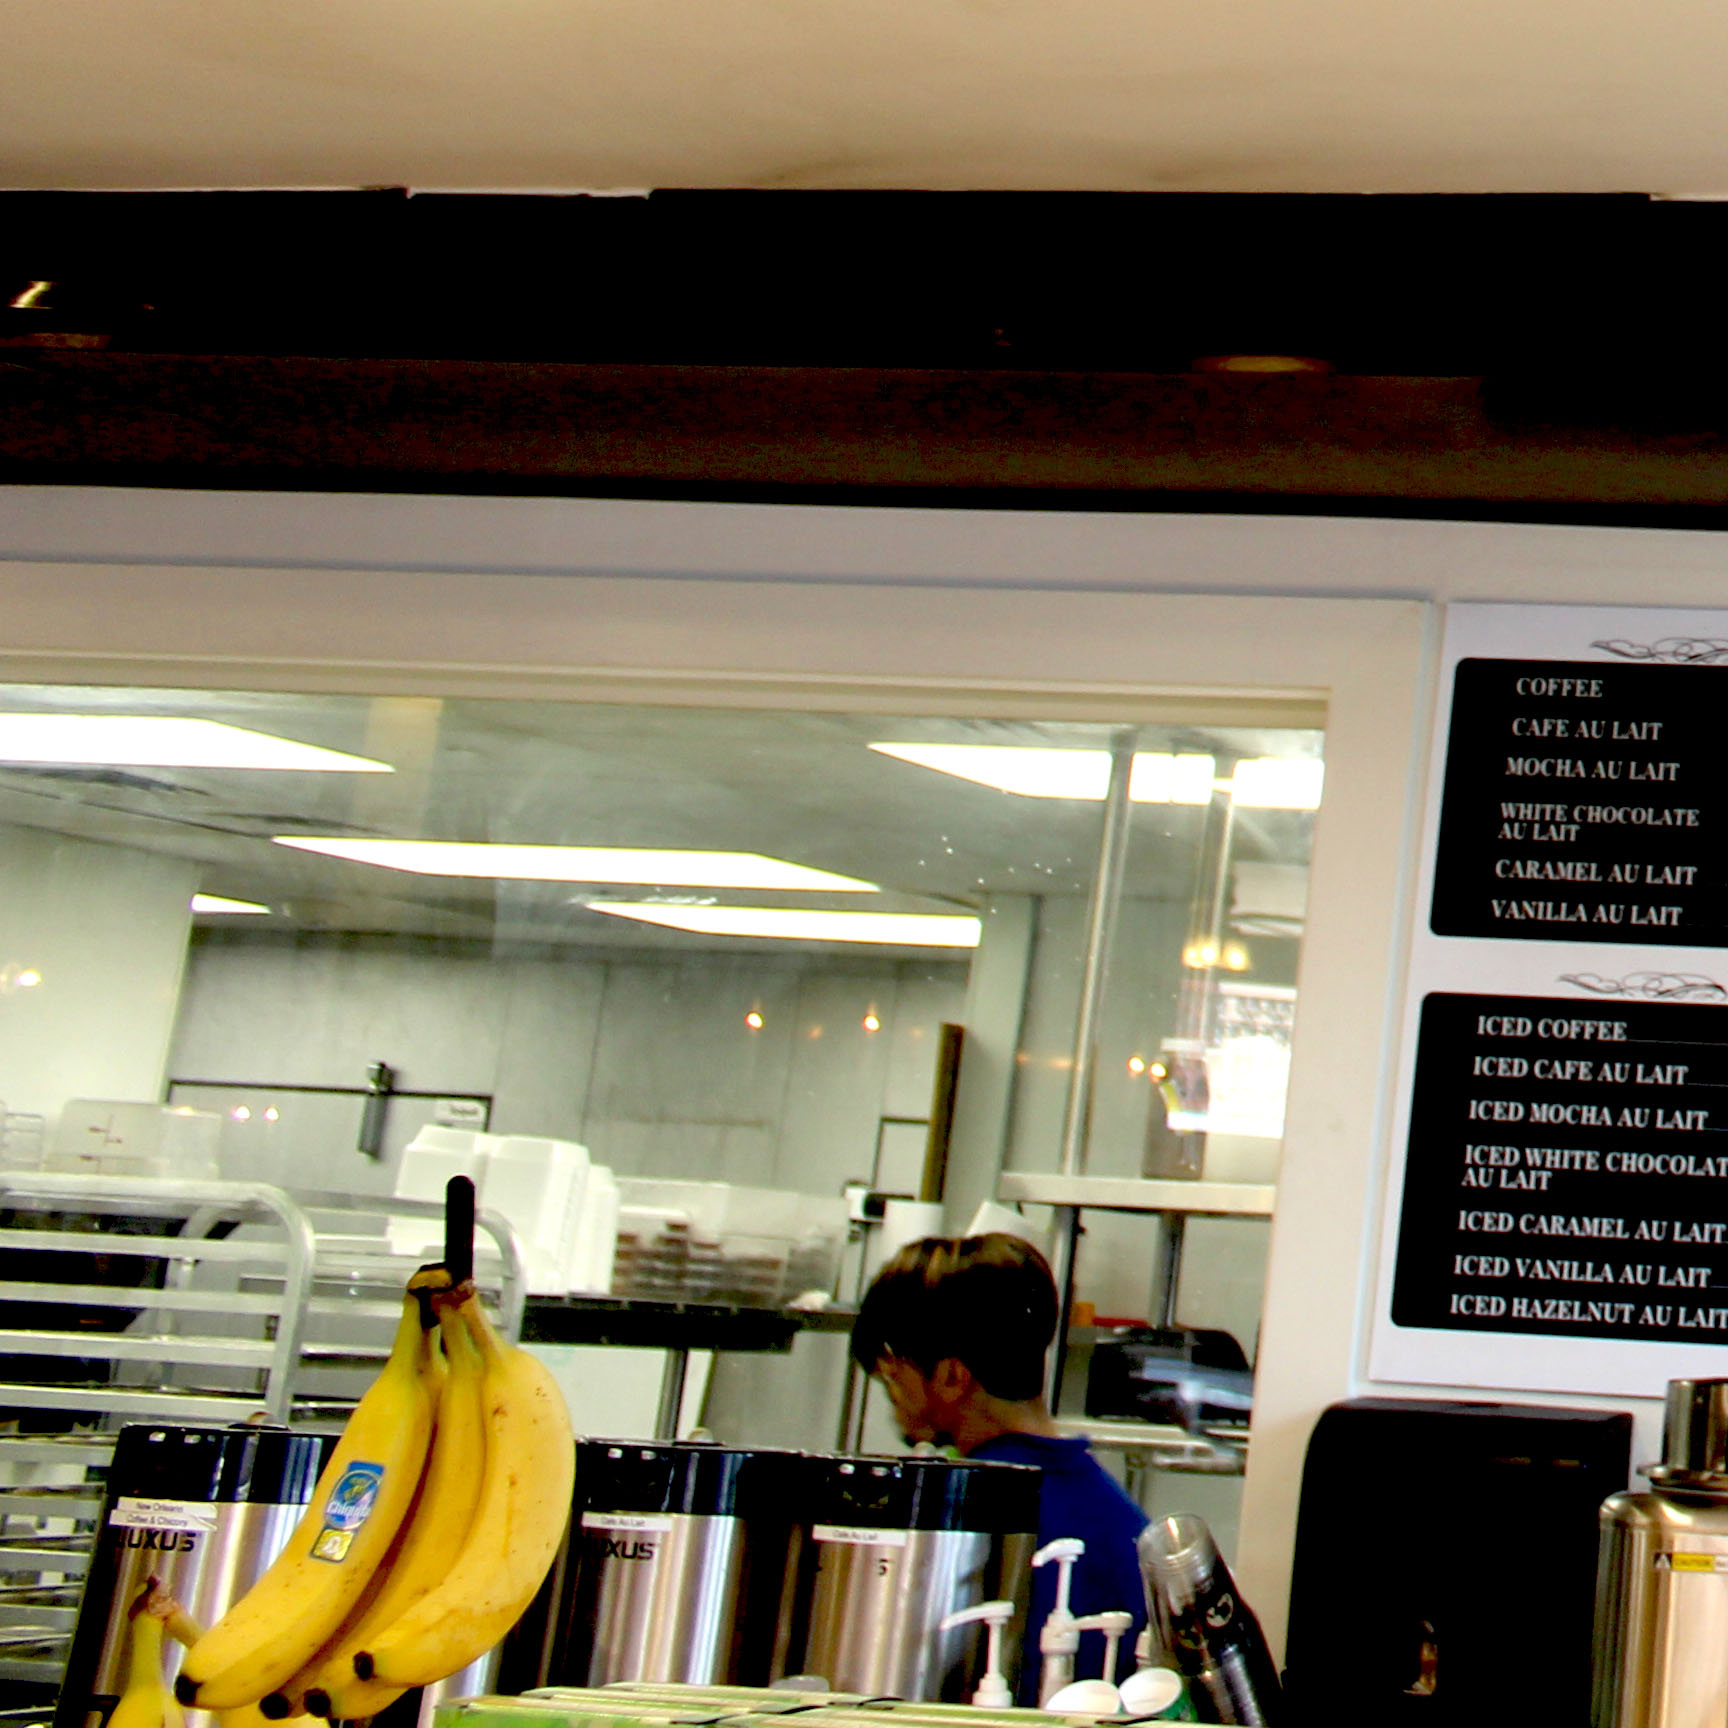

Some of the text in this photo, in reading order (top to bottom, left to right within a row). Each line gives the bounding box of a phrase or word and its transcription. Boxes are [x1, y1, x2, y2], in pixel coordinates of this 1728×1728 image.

[1516, 678, 1603, 697] COFFEE
[1513, 717, 1663, 741] CAFE AU LAIT
[1506, 757, 1679, 782] MOCHA AU LAIT
[1500, 802, 1700, 827] WHITE CHOCOLATE
[1498, 822, 1580, 842] AU LAIT
[1495, 859, 1697, 886] CARAMEL AU LAIT
[1492, 900, 1682, 926] VANILLA AU LAIT
[1477, 1015, 1627, 1041] ICED COFFEE
[1473, 1056, 1688, 1086] ICED CAFE AU LAIT
[1469, 1100, 1708, 1131] ICED MOCHA AU LAIT
[1464, 1144, 1521, 1166] ICED
[1525, 1148, 1600, 1171] WHITE
[1462, 1167, 1552, 1191] AU LAIT
[1458, 1210, 1726, 1244] ICED CARAMEL AU LAIT
[1454, 1254, 1711, 1288] ICED VANILLA AU LAIT
[1450, 1293, 1506, 1317] ICED
[1511, 1297, 1635, 1324] HAZELNUT
[1639, 1305, 1672, 1327] AU
[119, 1528, 196, 1552] UXUS
